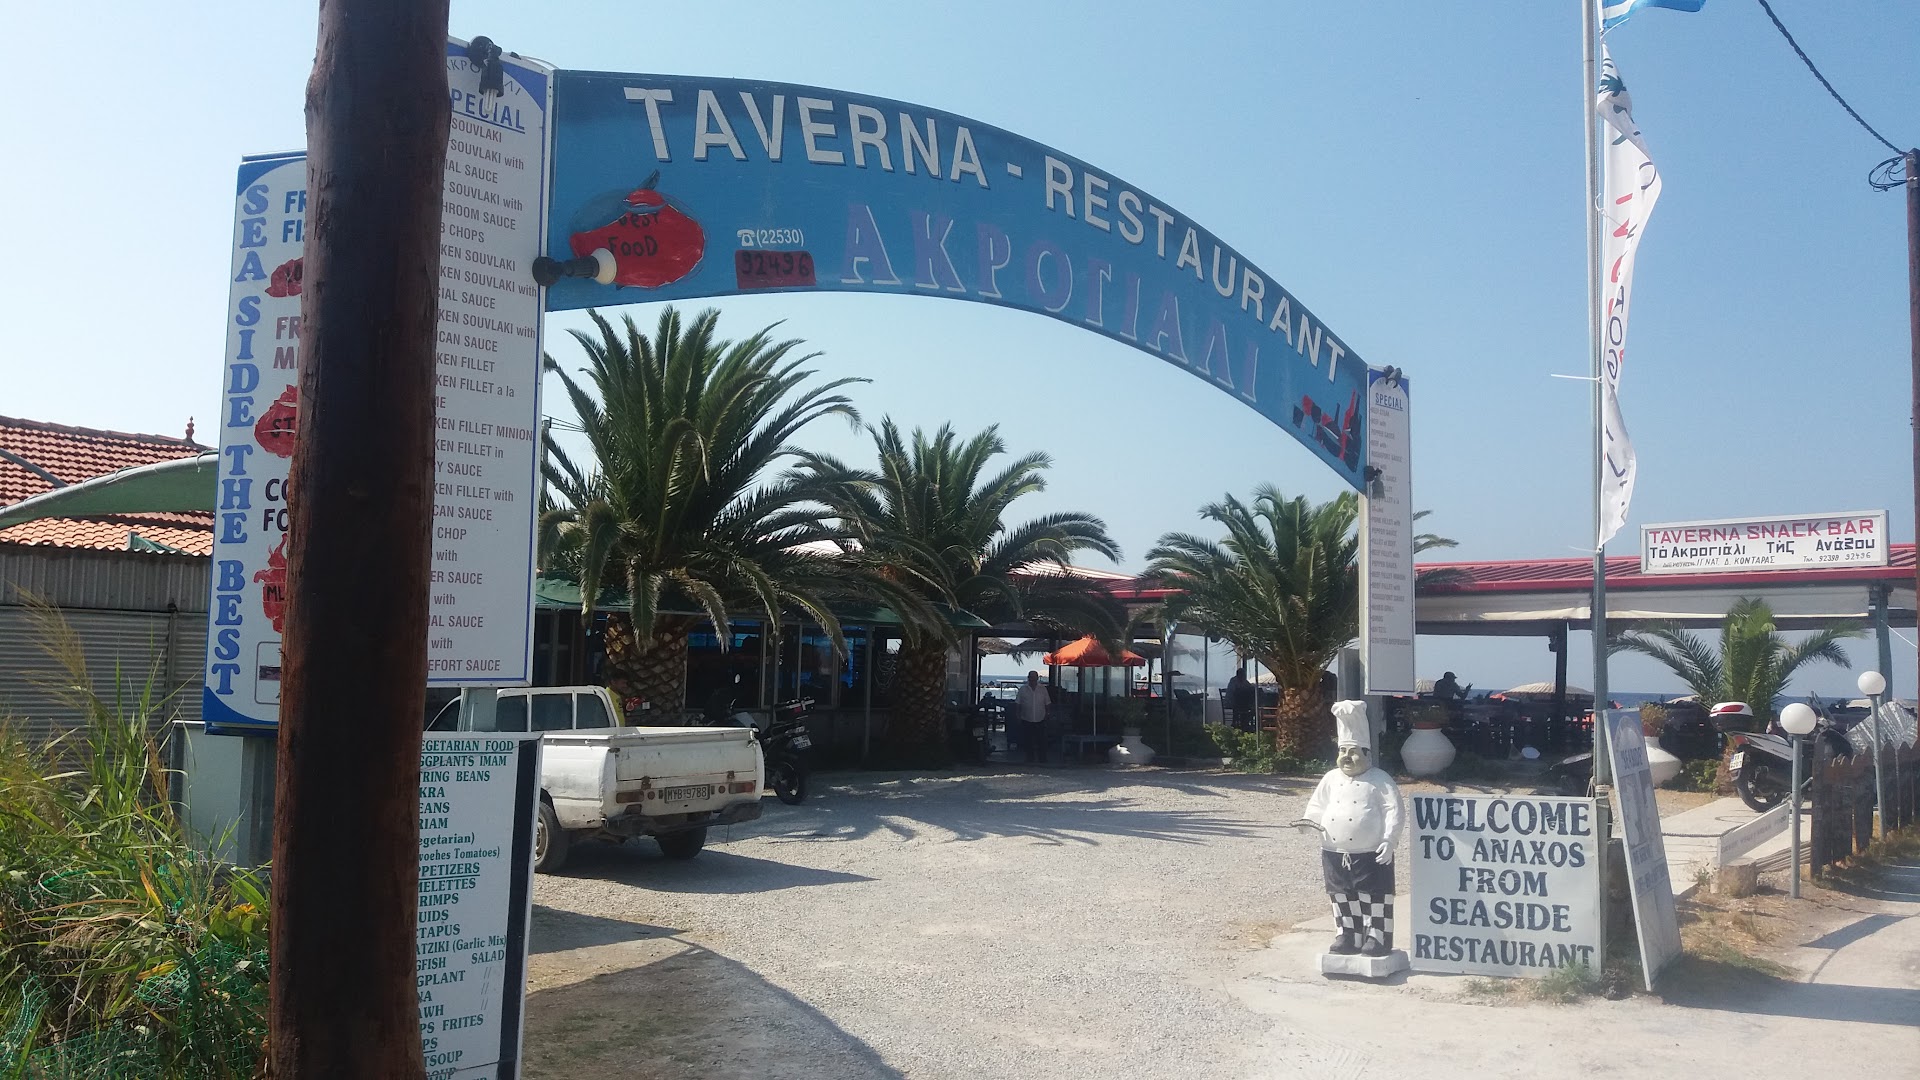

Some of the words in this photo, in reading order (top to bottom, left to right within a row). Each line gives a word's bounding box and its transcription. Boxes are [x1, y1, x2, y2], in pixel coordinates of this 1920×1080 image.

[451, 88, 525, 130] PECIAL
[451, 117, 502, 143] SOUVLAKI
[450, 139, 501, 164] SOUVLAKI
[504, 157, 524, 170] with
[445, 159, 462, 173] IAL
[464, 164, 498, 184] SAUCE
[284, 190, 307, 214] FR
[449, 182, 500, 205] SOUVLAKI
[503, 198, 523, 211] with
[442, 202, 479, 220] HROOM
[483, 212, 516, 230] SAUCE
[449, 224, 485, 243] CHOPS
[624, 87, 989, 188] TAVERNA
[1045, 155, 1345, 384] RESTAURANT
[756, 228, 805, 248] (22530)
[440, 244, 461, 259] KEN
[465, 249, 515, 271] SOUVLAKI
[741, 251, 811, 276] 92496
[440, 265, 461, 280] KEN
[464, 271, 515, 292] SOUVLAKI
[518, 284, 537, 297] with
[462, 291, 496, 309] SAUCE
[438, 309, 459, 323] KEN
[463, 314, 513, 334] SOUVLAKI
[516, 326, 536, 339] with
[438, 331, 460, 345] CAN
[464, 335, 498, 352] SAUCE
[436, 352, 457, 366] KEN
[461, 357, 495, 373] FILLET
[436, 374, 457, 388] KEN
[460, 378, 494, 394] FILLET
[497, 386, 503, 396] a
[506, 386, 515, 397] la
[1375, 392, 1403, 410] SPECIAL
[435, 417, 455, 431] KEN
[459, 420, 493, 436] FILLET
[496, 425, 533, 441] MINION
[435, 438, 454, 452] KEN
[458, 441, 492, 457] FILLET
[495, 446, 504, 458] in
[447, 462, 482, 477] SAUCE
[220, 444, 254, 544] THE
[434, 483, 453, 496] KEN
[456, 485, 491, 499] FILLET
[494, 489, 514, 501] with
[433, 504, 454, 518] CAN
[458, 506, 492, 521] SAUCE
[437, 526, 467, 540] CHOP
[1649, 527, 1741, 544] TAVERNA
[1746, 521, 1821, 540] SNACK
[1827, 519, 1874, 536] BAR
[436, 549, 458, 561] with
[1734, 555, 1775, 565] ΚΟΝΤΑΡΑΣ
[431, 570, 444, 583] ER
[448, 571, 482, 585] SAUCE
[434, 593, 455, 605] with
[211, 559, 246, 695] BEST
[448, 615, 484, 628] SAUCE
[431, 637, 453, 649] with
[428, 659, 463, 671] EFORT
[465, 659, 501, 671] SAUCE
[421, 740, 480, 752] EGETARIAN
[485, 740, 514, 752] FOOD
[480, 755, 507, 766] IMAM
[456, 770, 491, 782] BEANS
[419, 786, 445, 798] KRA
[419, 801, 450, 814] EANS
[1414, 797, 1592, 836] WELCOME
[419, 817, 449, 830] RIAM
[419, 832, 475, 848] egetarian)
[454, 846, 500, 859] Tomatoes)
[1420, 835, 1456, 861] TO
[1471, 837, 1586, 868] ANAXOS
[418, 861, 480, 878] PETIZERS
[1458, 866, 1548, 897] FROM
[419, 892, 459, 907] RIMPS
[418, 909, 449, 923] UIDS
[1429, 896, 1572, 933] SEASIDE
[417, 923, 460, 939] TAPUS
[416, 940, 449, 955] ATZIKI
[452, 937, 485, 953] (Garlic
[488, 934, 507, 948] Mix)
[1414, 934, 1594, 970] RESTAURANT
[416, 956, 447, 972] GFISH
[471, 949, 504, 965] SALAD
[417, 970, 466, 988] GPLANT
[420, 1021, 435, 1035] PS
[442, 1013, 484, 1031] FRITES
[422, 1036, 438, 1051] PS
[424, 1050, 463, 1067] TSOUP
